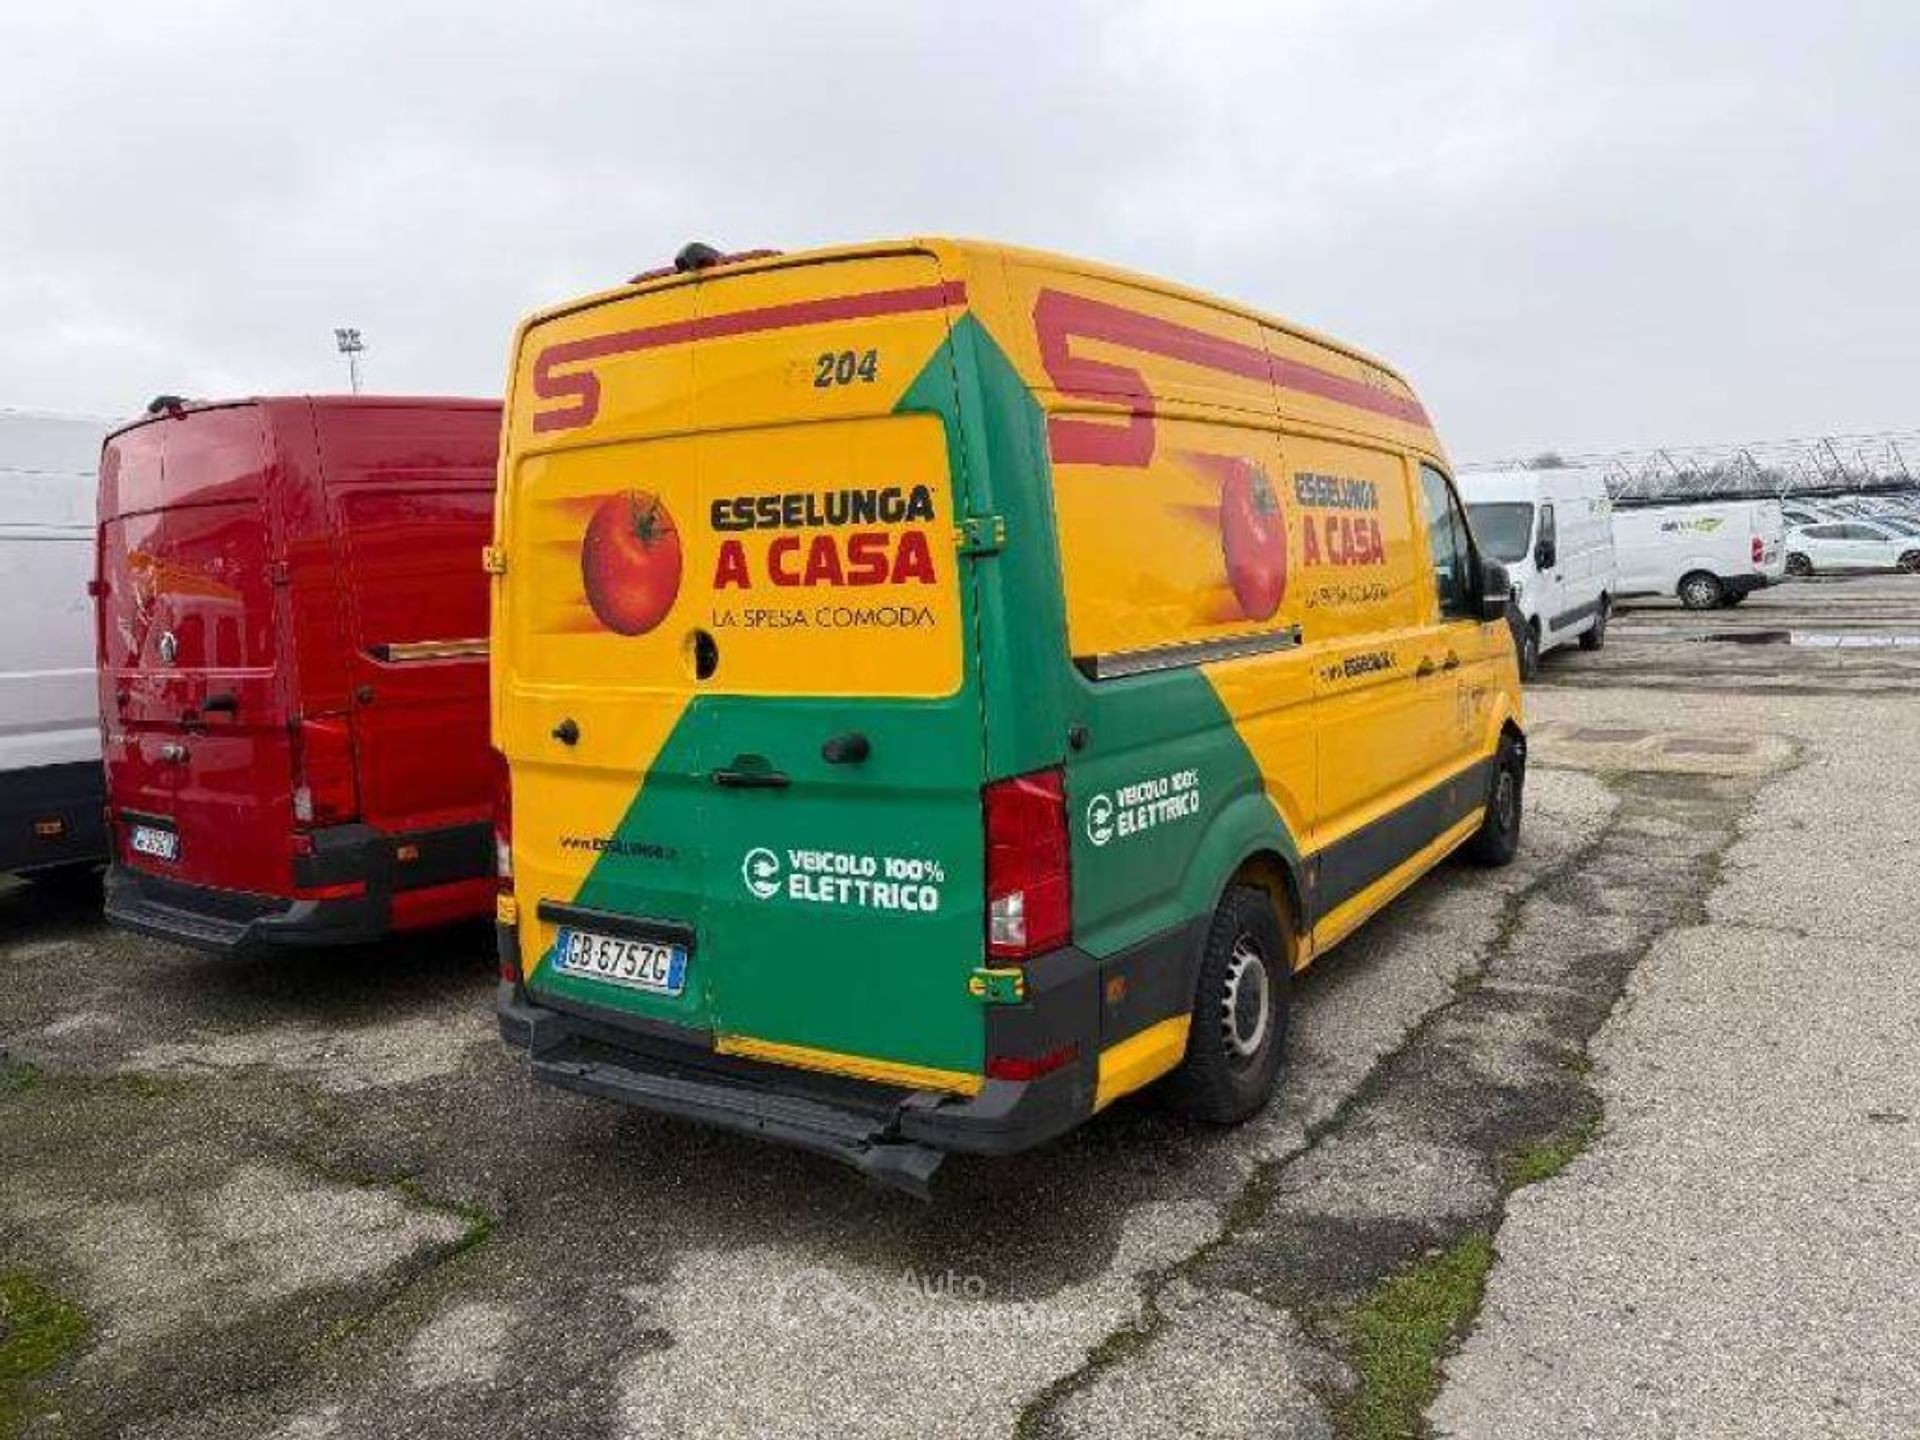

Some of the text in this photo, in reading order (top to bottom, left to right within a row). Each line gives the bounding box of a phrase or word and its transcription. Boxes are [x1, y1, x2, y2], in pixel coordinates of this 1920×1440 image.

[814, 348, 877, 387] 204
[711, 485, 935, 531] ESSELUNGA
[713, 531, 936, 589] A CASA
[1303, 515, 1386, 567] A CASA
[712, 606, 935, 629] LA SPESA COMODA
[1116, 778, 1168, 808] VEICOLO
[1117, 790, 1200, 837] ELETTRICO
[787, 850, 945, 883] VEICOLO 100%
[789, 874, 938, 911] ELETTRICO
